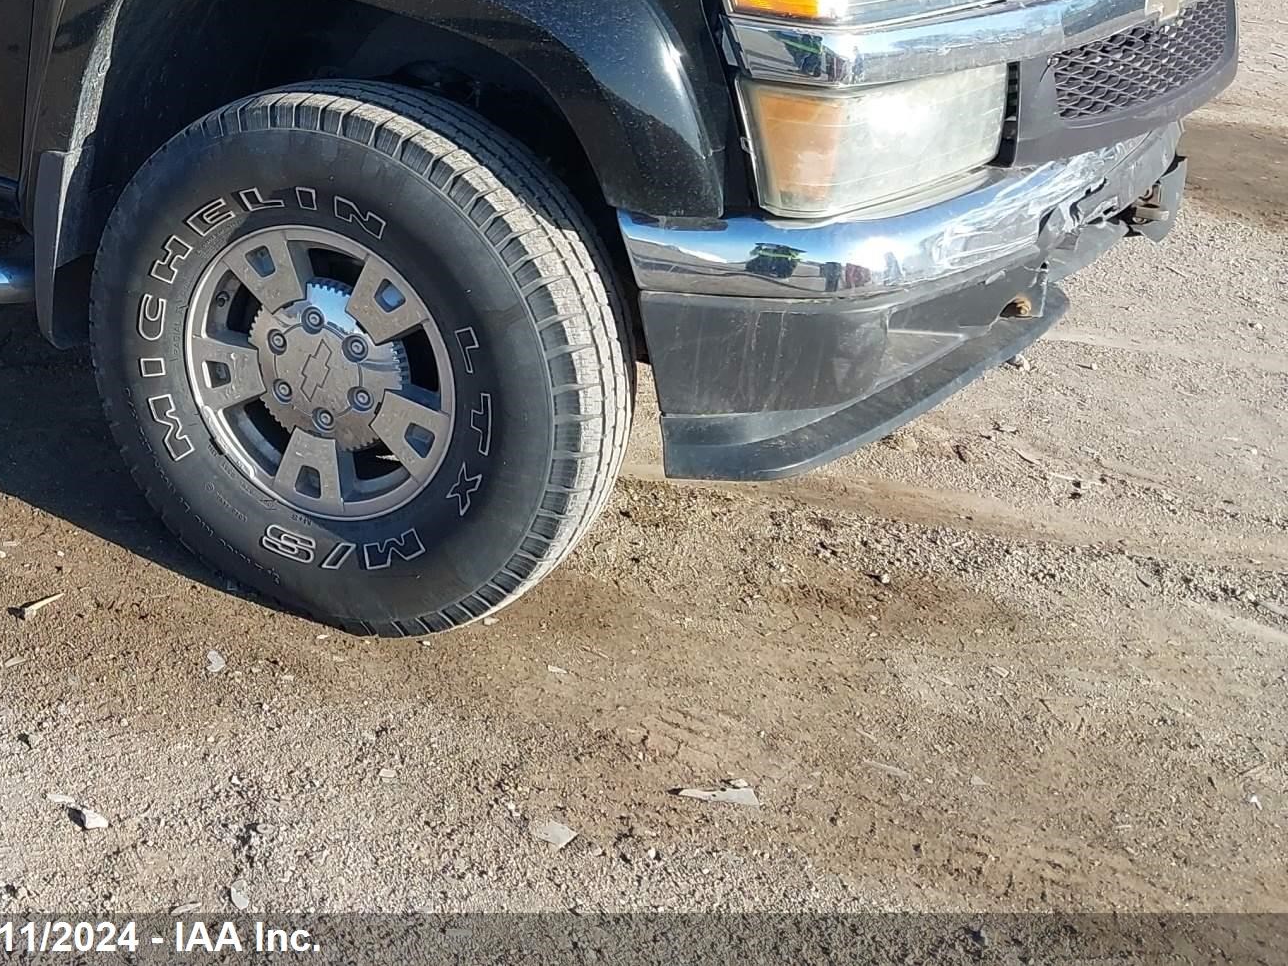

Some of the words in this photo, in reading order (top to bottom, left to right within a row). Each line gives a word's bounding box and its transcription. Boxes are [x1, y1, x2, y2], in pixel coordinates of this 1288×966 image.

[137, 186, 387, 462] MICHELIN
[445, 326, 493, 516] LTX
[261, 522, 428, 571] M/S
